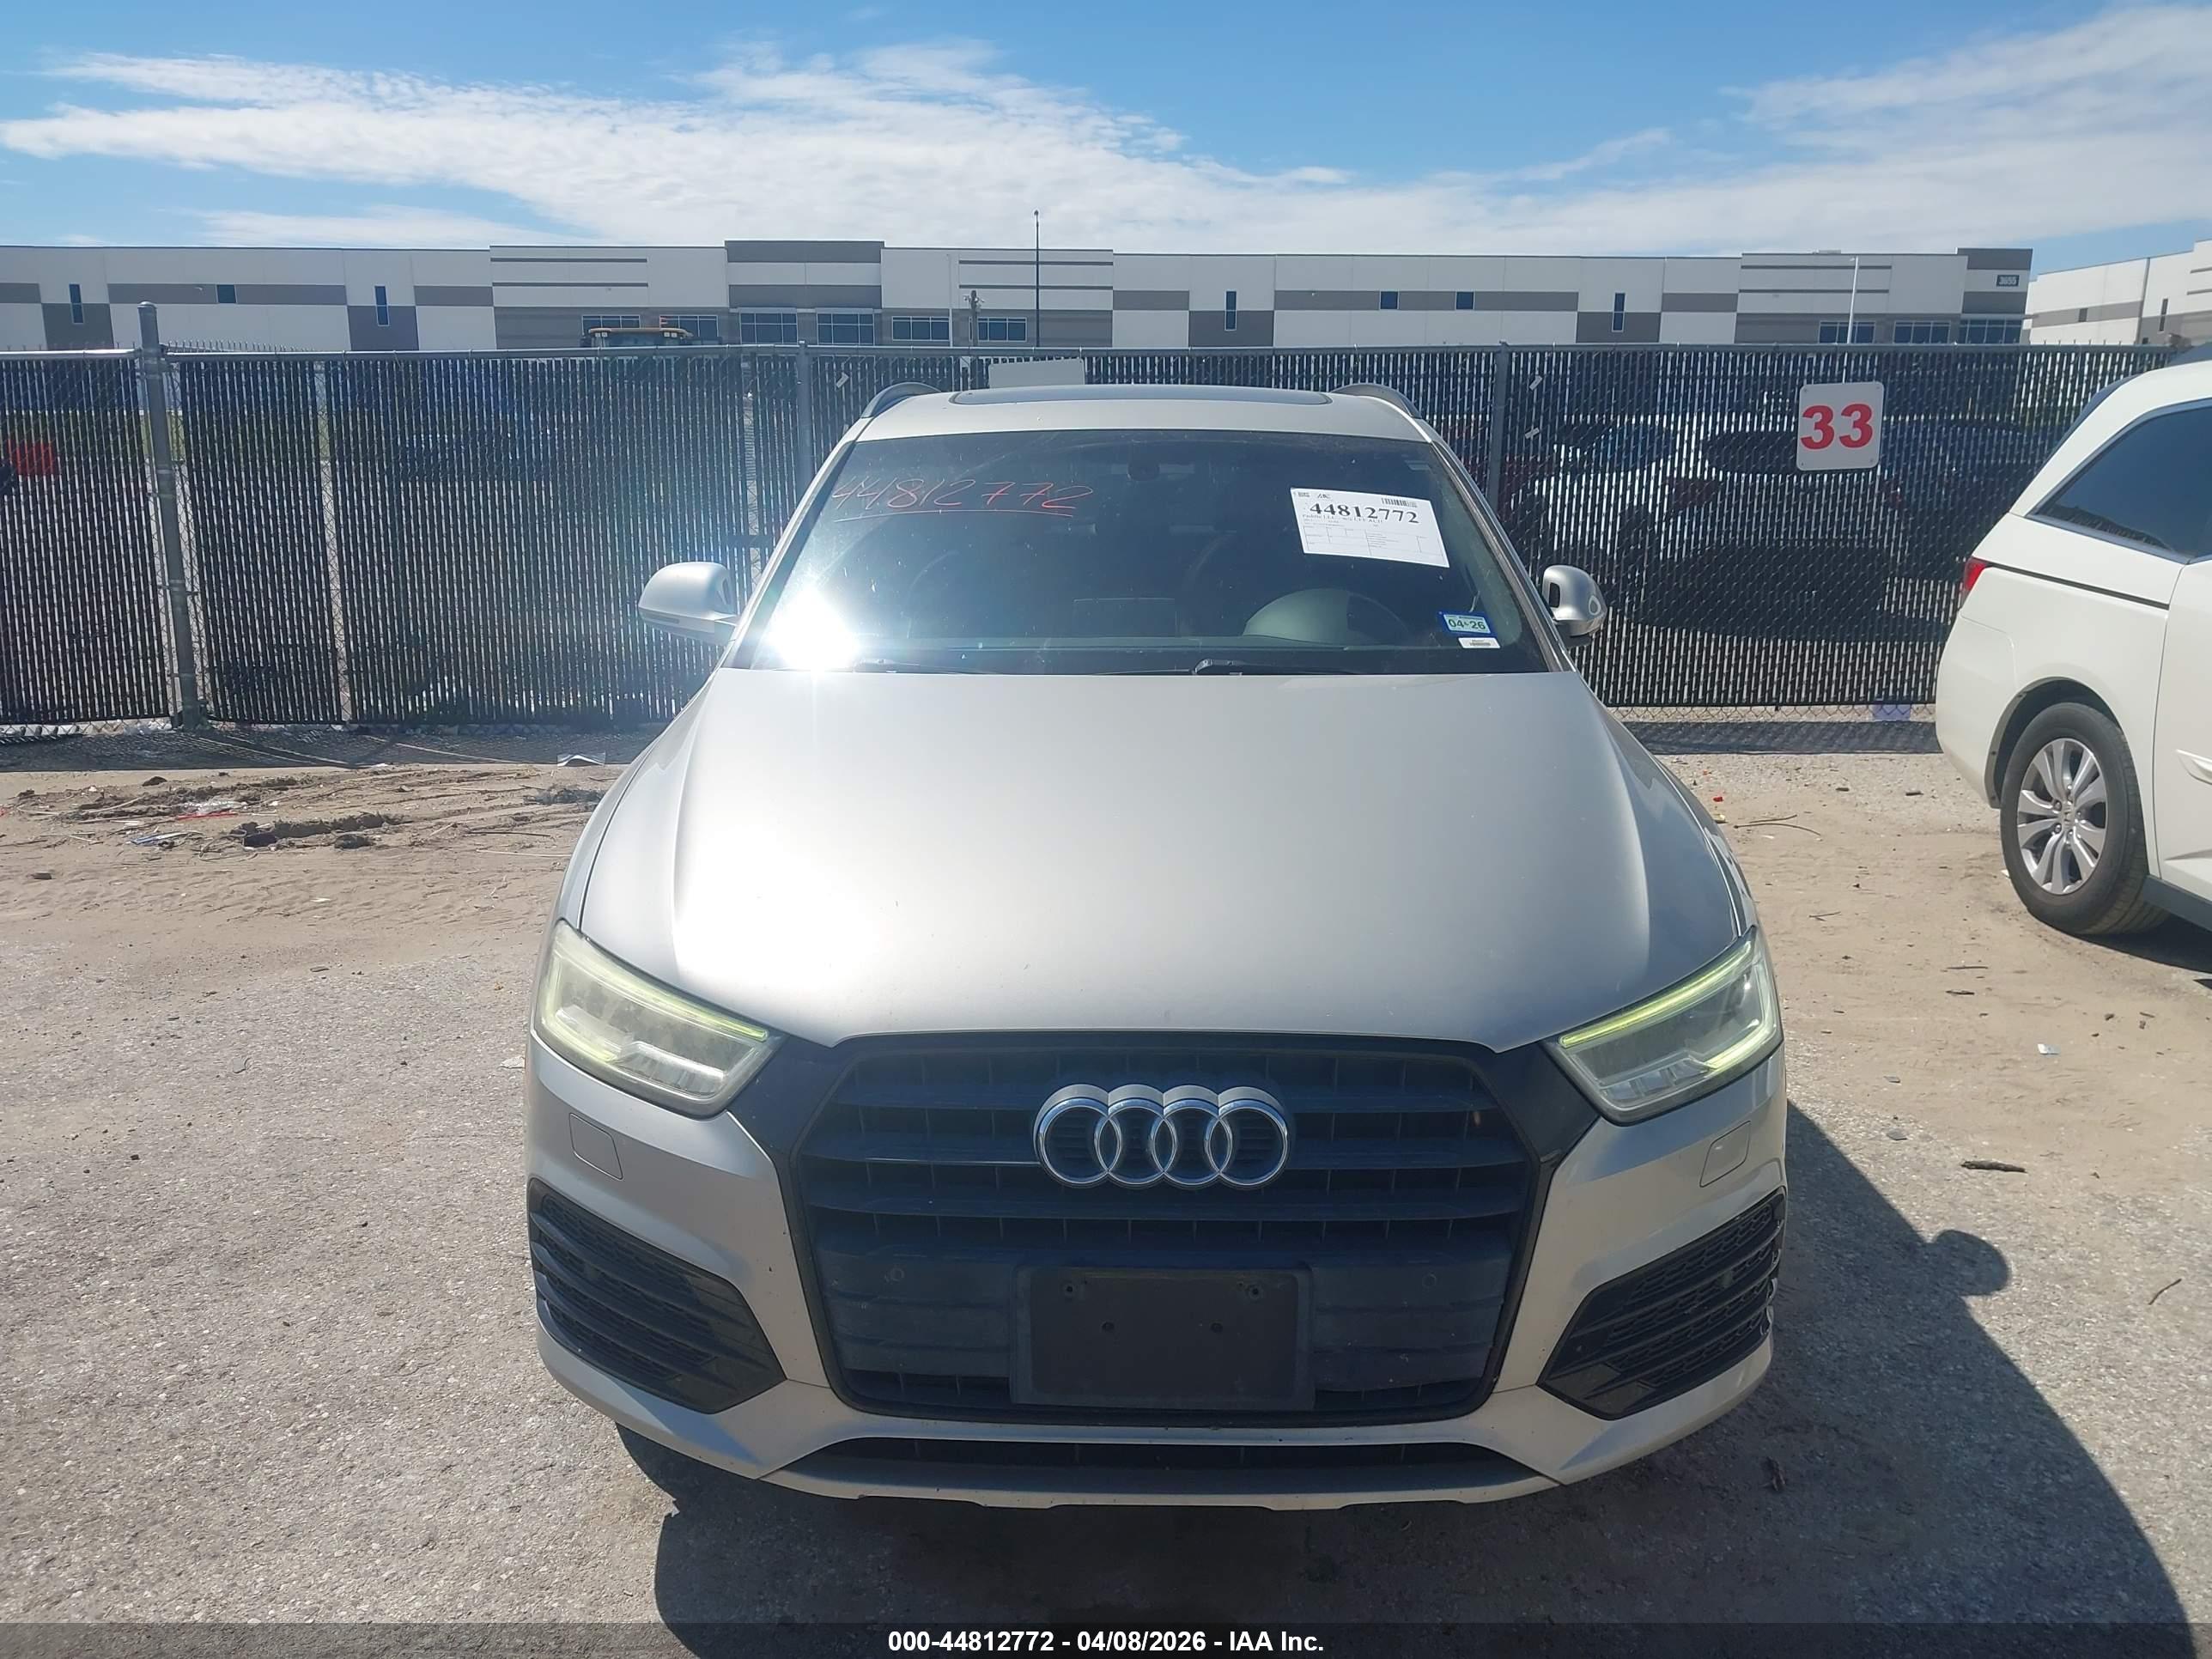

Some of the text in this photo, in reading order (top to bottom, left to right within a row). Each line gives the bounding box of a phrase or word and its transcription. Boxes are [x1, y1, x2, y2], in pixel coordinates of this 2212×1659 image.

[1801, 404, 1873, 450] 33
[832, 476, 1093, 509] 44812772
[1310, 503, 1419, 524] 44812772
